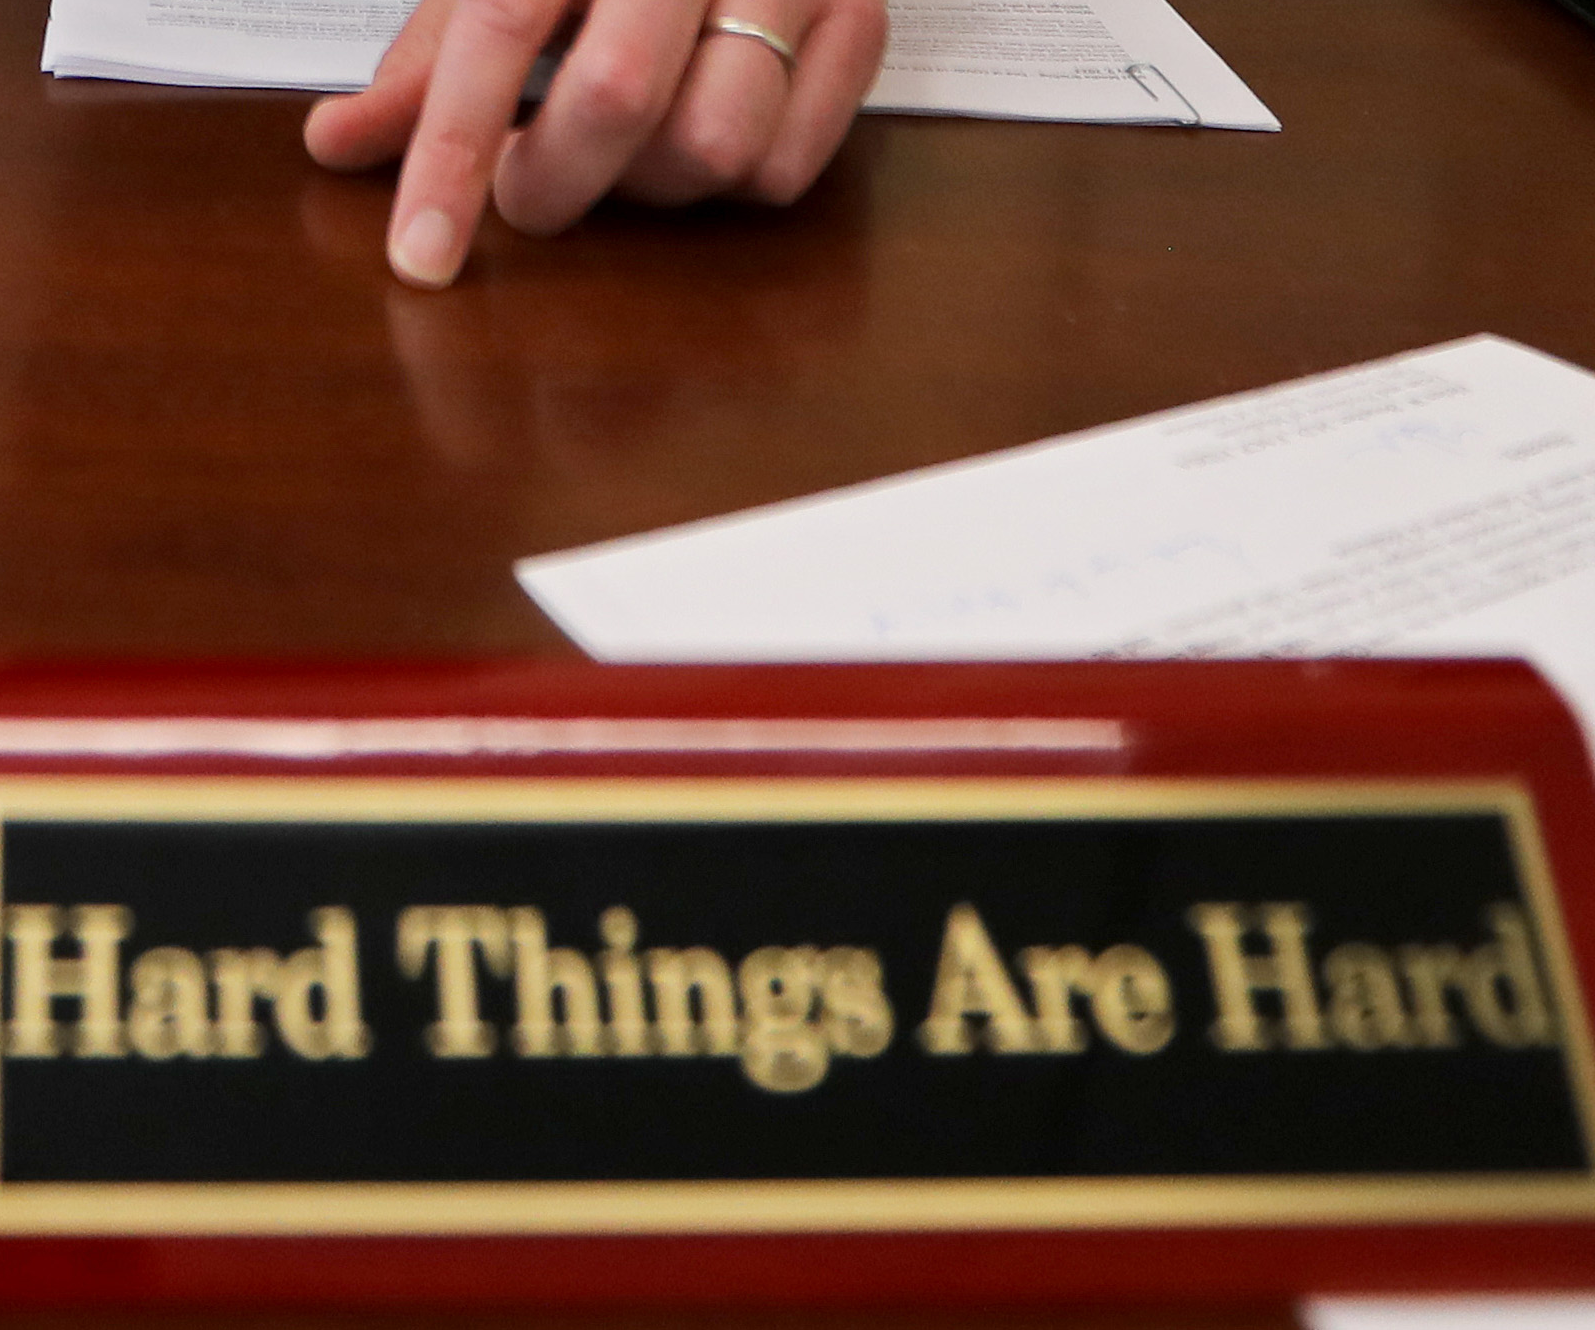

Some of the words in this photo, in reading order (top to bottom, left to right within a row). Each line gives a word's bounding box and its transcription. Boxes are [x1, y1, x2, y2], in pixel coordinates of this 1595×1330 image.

[1, 903, 373, 1062] Hard
[395, 903, 895, 1093] Things
[915, 898, 1177, 1056] Are
[1185, 898, 1567, 1052] Hard
